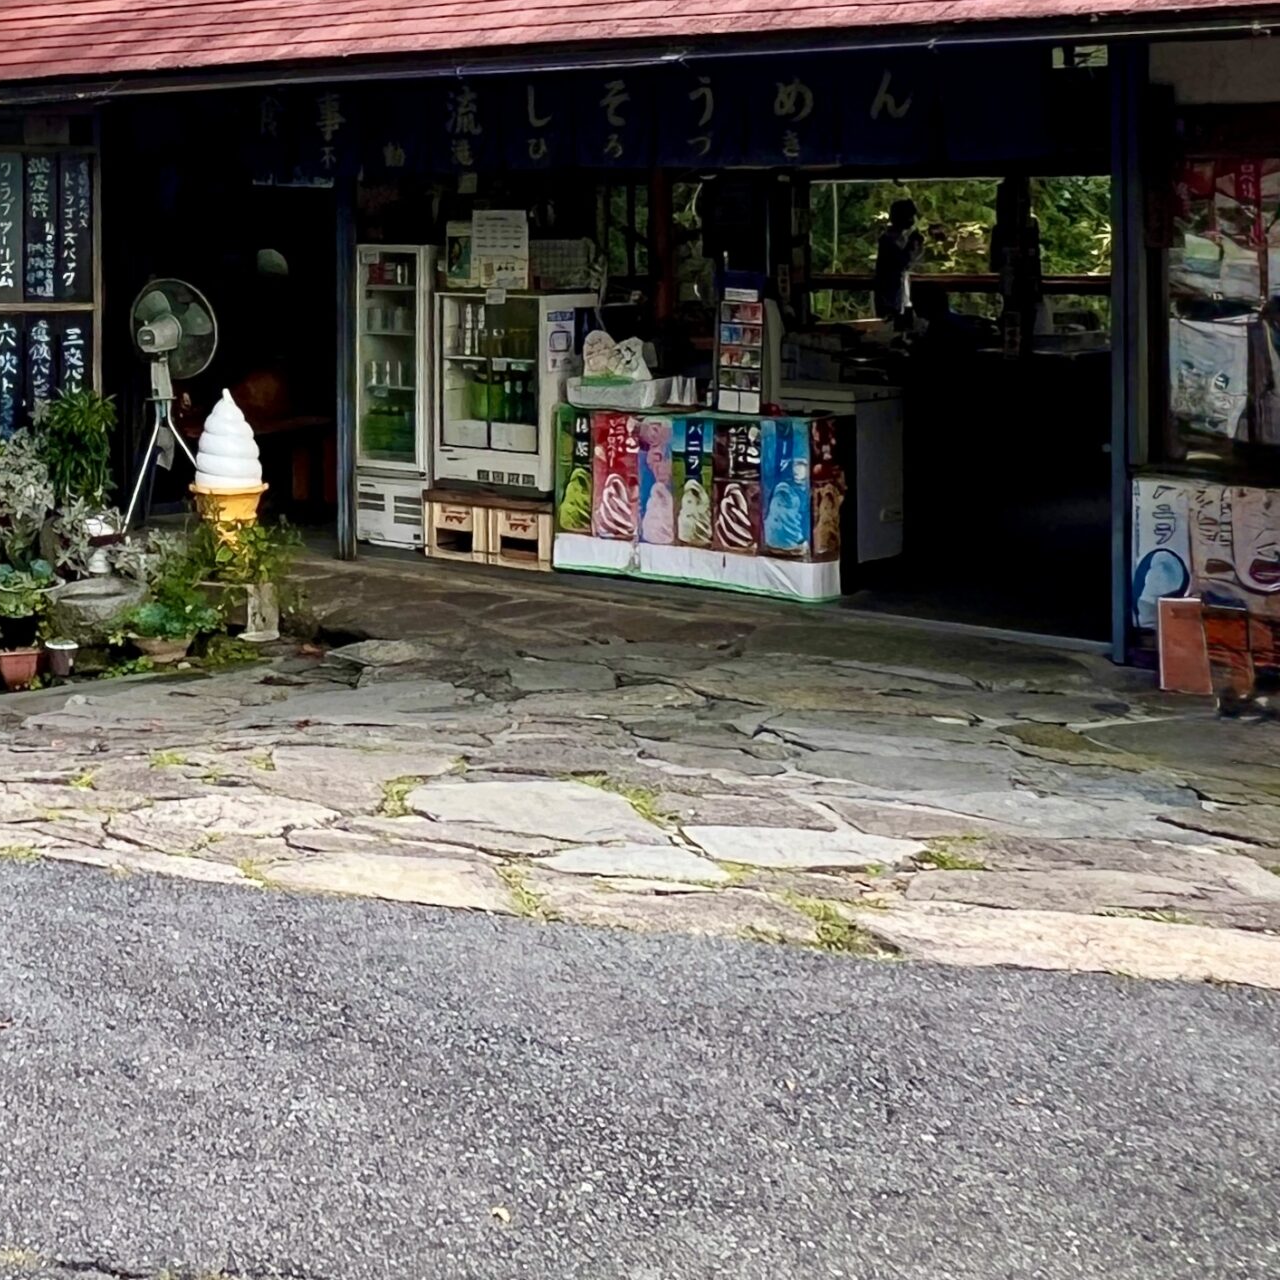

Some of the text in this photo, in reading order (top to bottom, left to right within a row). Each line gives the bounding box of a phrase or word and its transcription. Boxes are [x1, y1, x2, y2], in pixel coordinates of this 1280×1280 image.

[445, 70, 911, 137] 流しそうめん
[687, 423, 702, 470] バニラ
